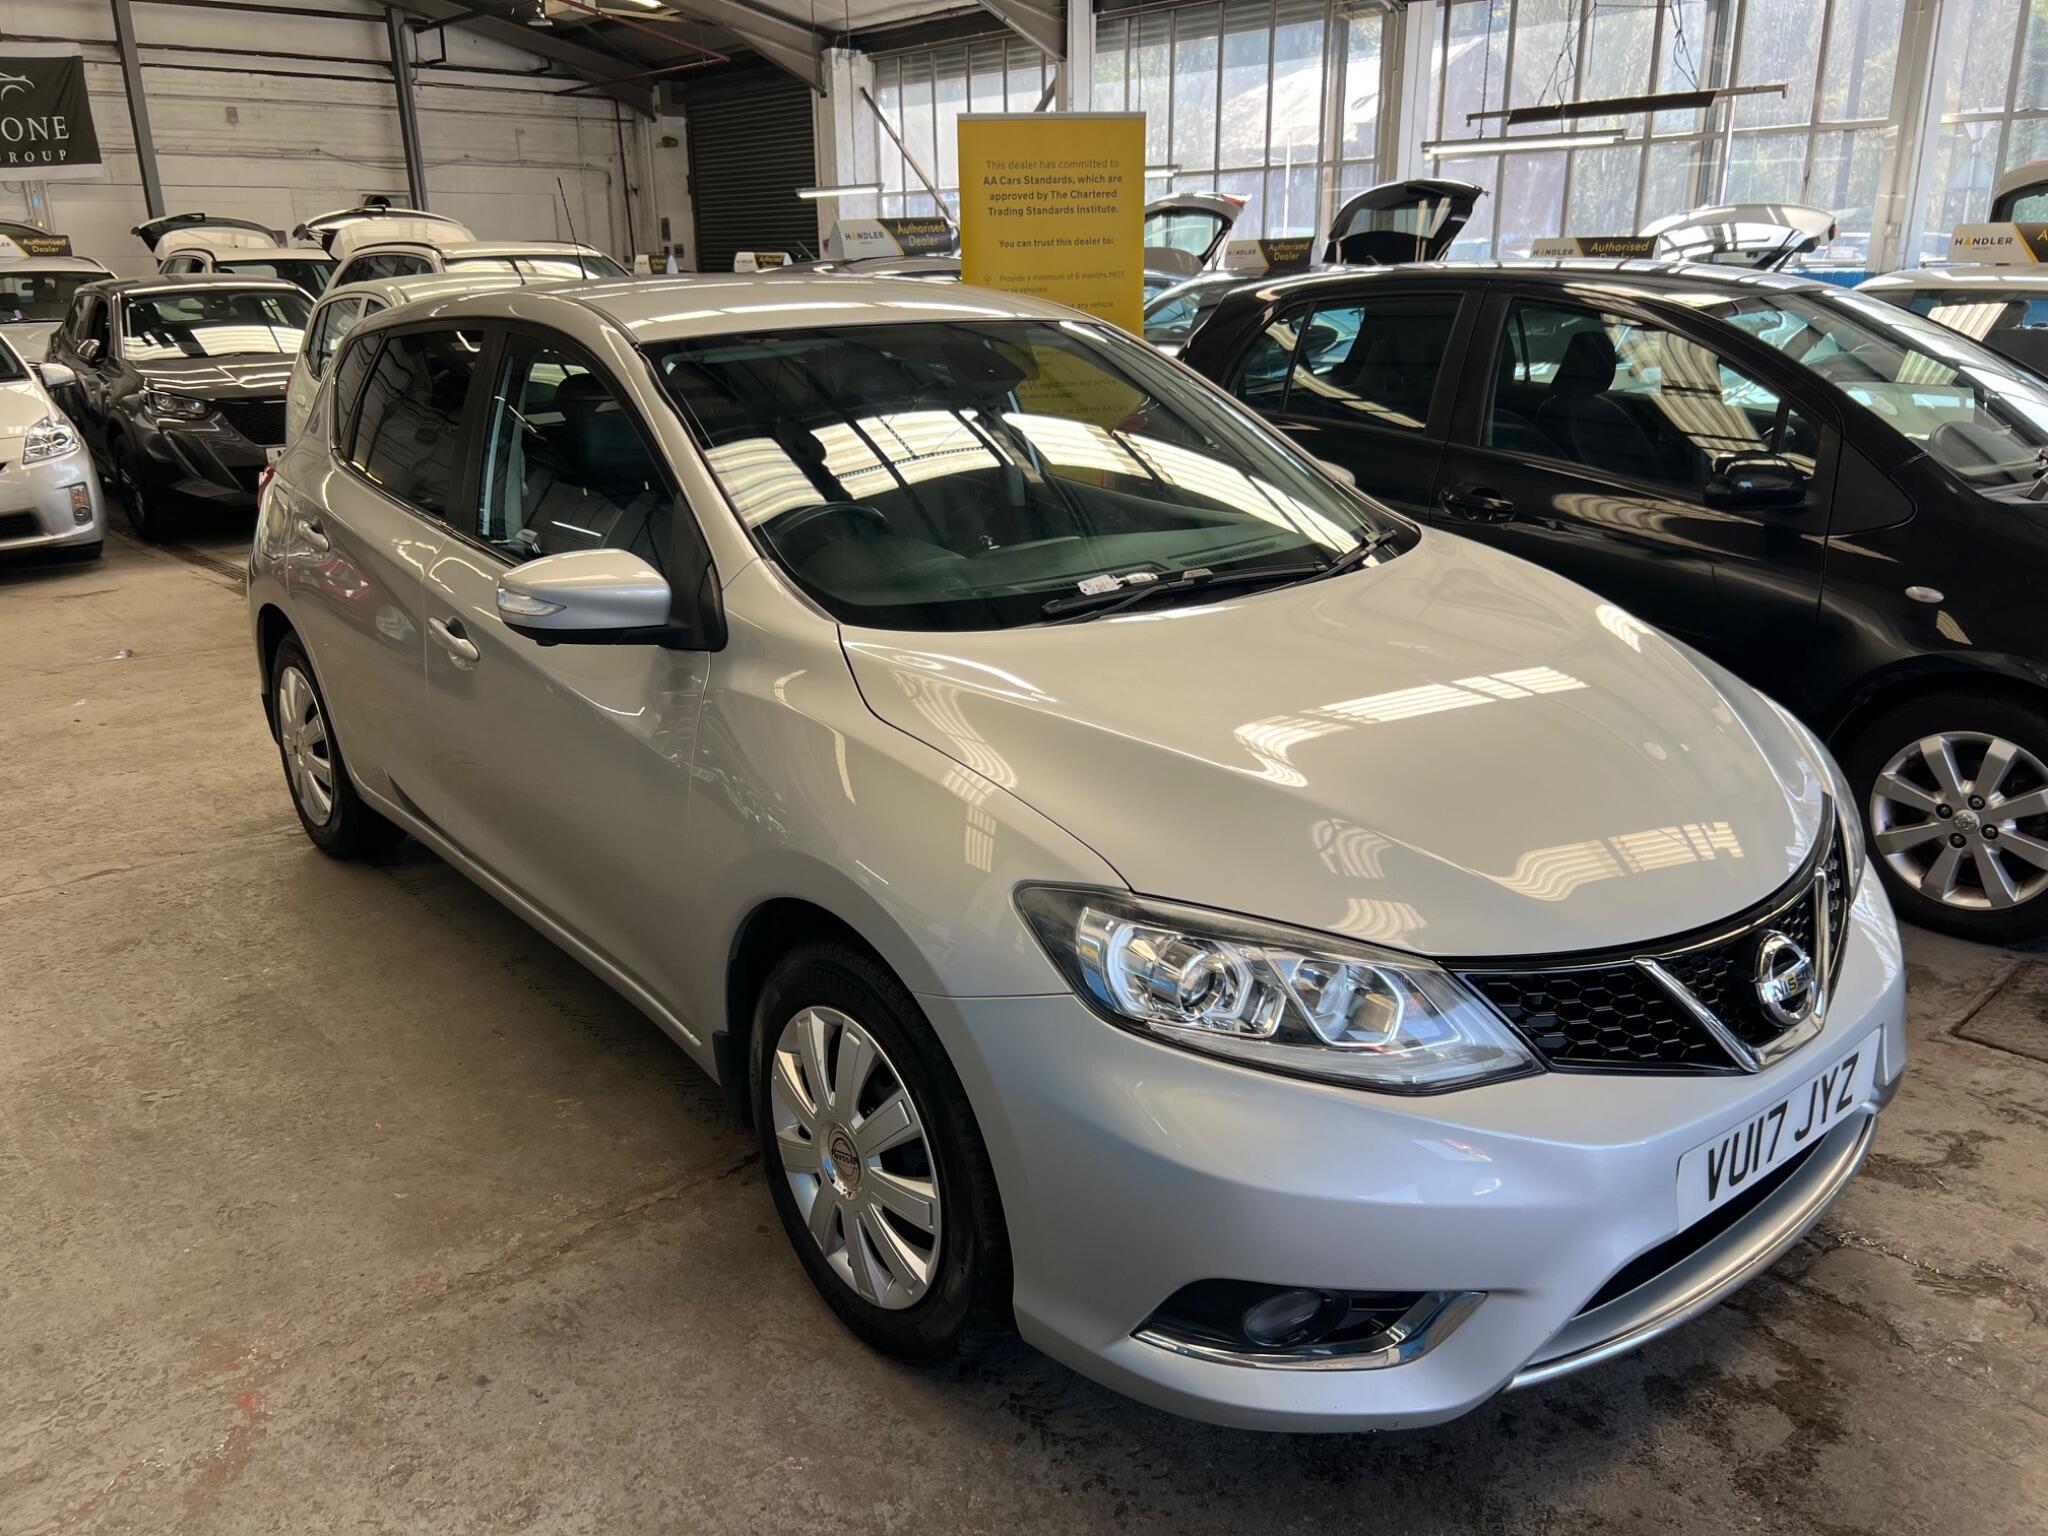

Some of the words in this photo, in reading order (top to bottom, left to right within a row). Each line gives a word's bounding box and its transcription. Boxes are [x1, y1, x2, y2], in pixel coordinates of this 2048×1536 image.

[0, 149, 67, 163] ROUP
[987, 160, 1006, 170] This
[1008, 160, 1037, 170] dealer
[1040, 160, 1056, 169] has
[1058, 159, 1108, 169] committed
[1110, 159, 1120, 169] to
[984, 176, 997, 186] AA
[1000, 176, 1021, 186] Cars
[1023, 175, 1076, 185] Standards,
[1077, 174, 1105, 183] which
[1107, 175, 1123, 183] are
[989, 191, 1035, 202] approved
[1037, 191, 1048, 202] by
[1050, 190, 1068, 199] The
[1070, 189, 1117, 199] Chartered
[987, 207, 1024, 218] Trading
[1026, 205, 1075, 215] Standards
[1077, 204, 1119, 215] Institute.
[898, 221, 946, 234] Authorised
[909, 235, 939, 247] Dealer
[999, 239, 1015, 248] You
[1017, 240, 1032, 248] can
[1034, 239, 1055, 247] trust
[1056, 238, 1073, 247] this
[1074, 237, 1100, 246] dealer
[1102, 237, 1114, 245] to:
[1267, 241, 1309, 251] Authorised
[1590, 241, 1649, 252] Authorised
[32, 245, 59, 253] Dealer
[1273, 252, 1299, 261] Dealer
[999, 274, 1025, 283] Provide
[1032, 273, 1065, 281] minimum
[1067, 272, 1074, 280] of
[1081, 271, 1107, 280] months
[1108, 270, 1125, 279] MOT
[1020, 286, 1047, 294] vehicles
[1077, 303, 1088, 311] any
[1090, 301, 1114, 309] vehicle
[1708, 1100, 1789, 1202] VU17
[1794, 1052, 1860, 1142] JYZ
